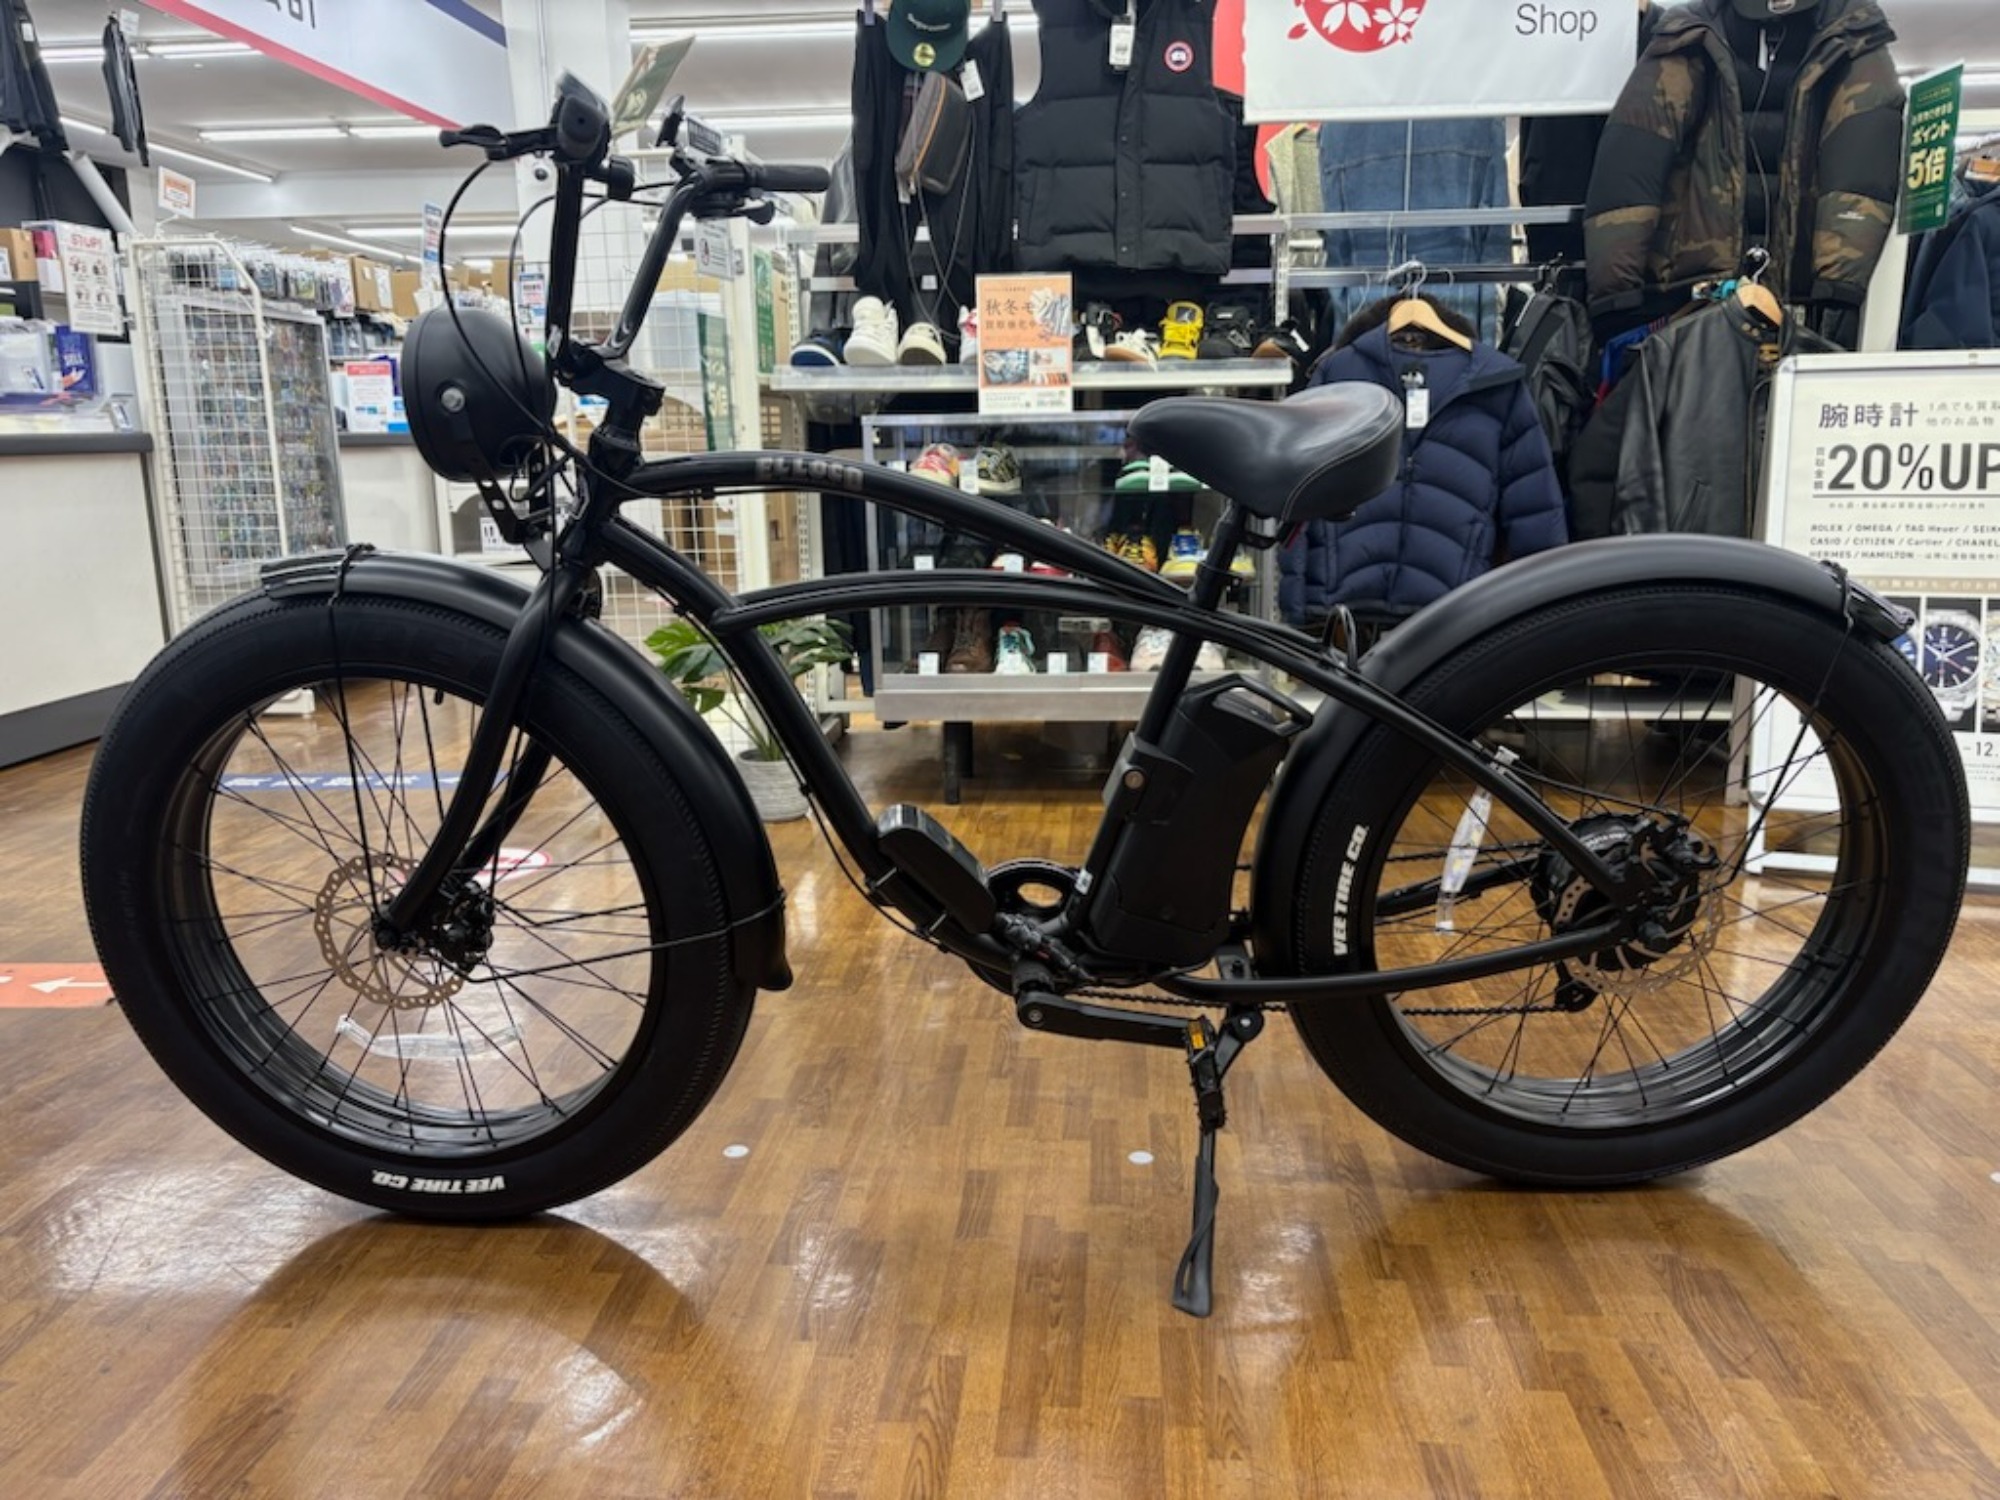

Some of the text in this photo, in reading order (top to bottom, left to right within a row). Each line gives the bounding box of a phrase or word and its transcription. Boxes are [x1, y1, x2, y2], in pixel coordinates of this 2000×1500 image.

[1515, 4, 1598, 40] Shop
[1910, 119, 1951, 147] ポイント
[1907, 146, 1948, 189] 5倍
[1818, 402, 1919, 428] 腕時計
[1827, 442, 2000, 491] 20%UP
[1810, 524, 1843, 532] ROLEX
[1855, 524, 1893, 532] OMEGA
[1810, 537, 1841, 545] CASIO
[1853, 537, 1895, 545] CITIZEN
[1955, 538, 2000, 547] CHANEL
[1334, 860, 1355, 915] TIRE
[1333, 915, 1349, 956] VEE
[409, 1177, 463, 1194] TIRE
[465, 1175, 506, 1194] VEE
